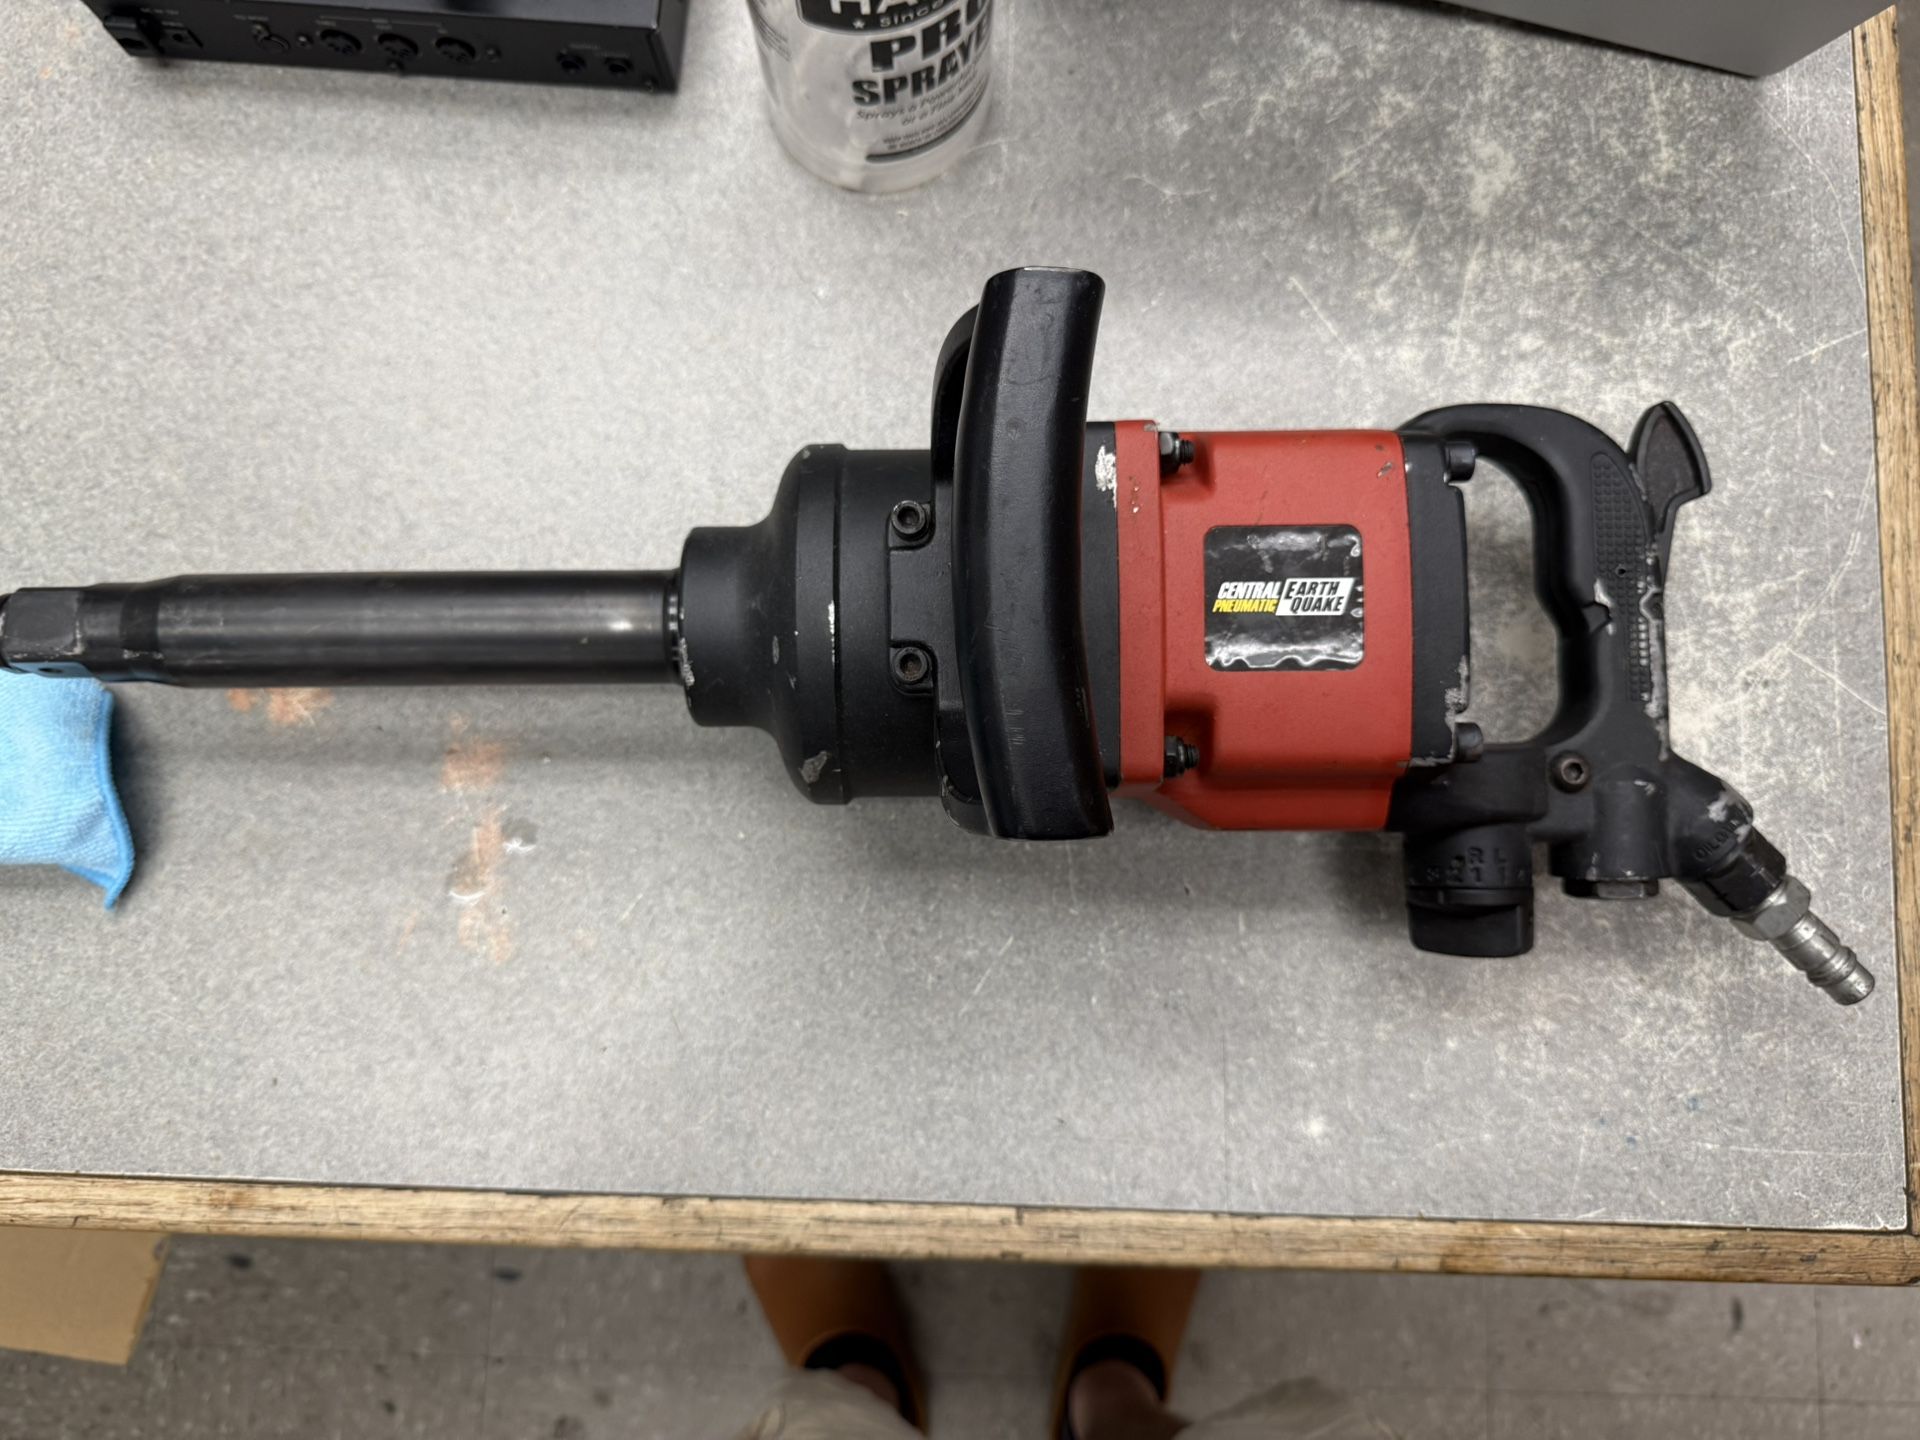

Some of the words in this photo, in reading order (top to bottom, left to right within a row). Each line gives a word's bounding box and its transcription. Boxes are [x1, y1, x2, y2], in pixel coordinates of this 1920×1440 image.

[1217, 581, 1282, 599] CENTRAL
[1284, 581, 1340, 600] EARTH
[1212, 599, 1279, 613] PNEUMATIC
[1291, 596, 1344, 614] QUAKE
